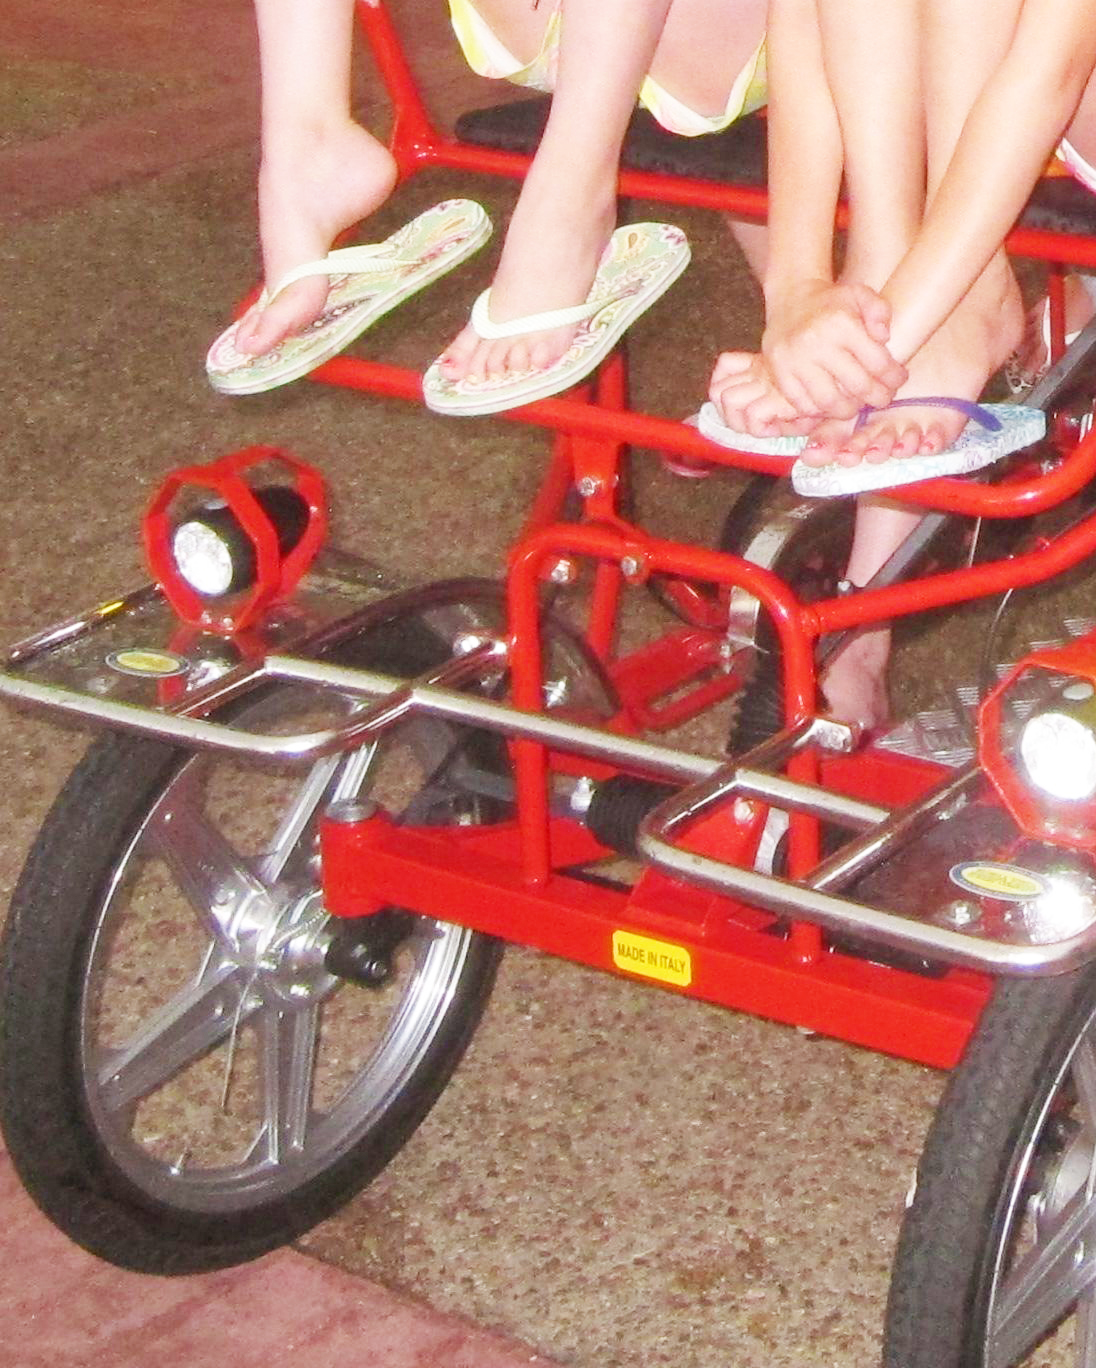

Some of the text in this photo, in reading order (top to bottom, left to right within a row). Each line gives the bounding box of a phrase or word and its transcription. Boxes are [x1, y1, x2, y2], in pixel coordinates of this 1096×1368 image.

[617, 942, 686, 974] MADE IN ITALY
